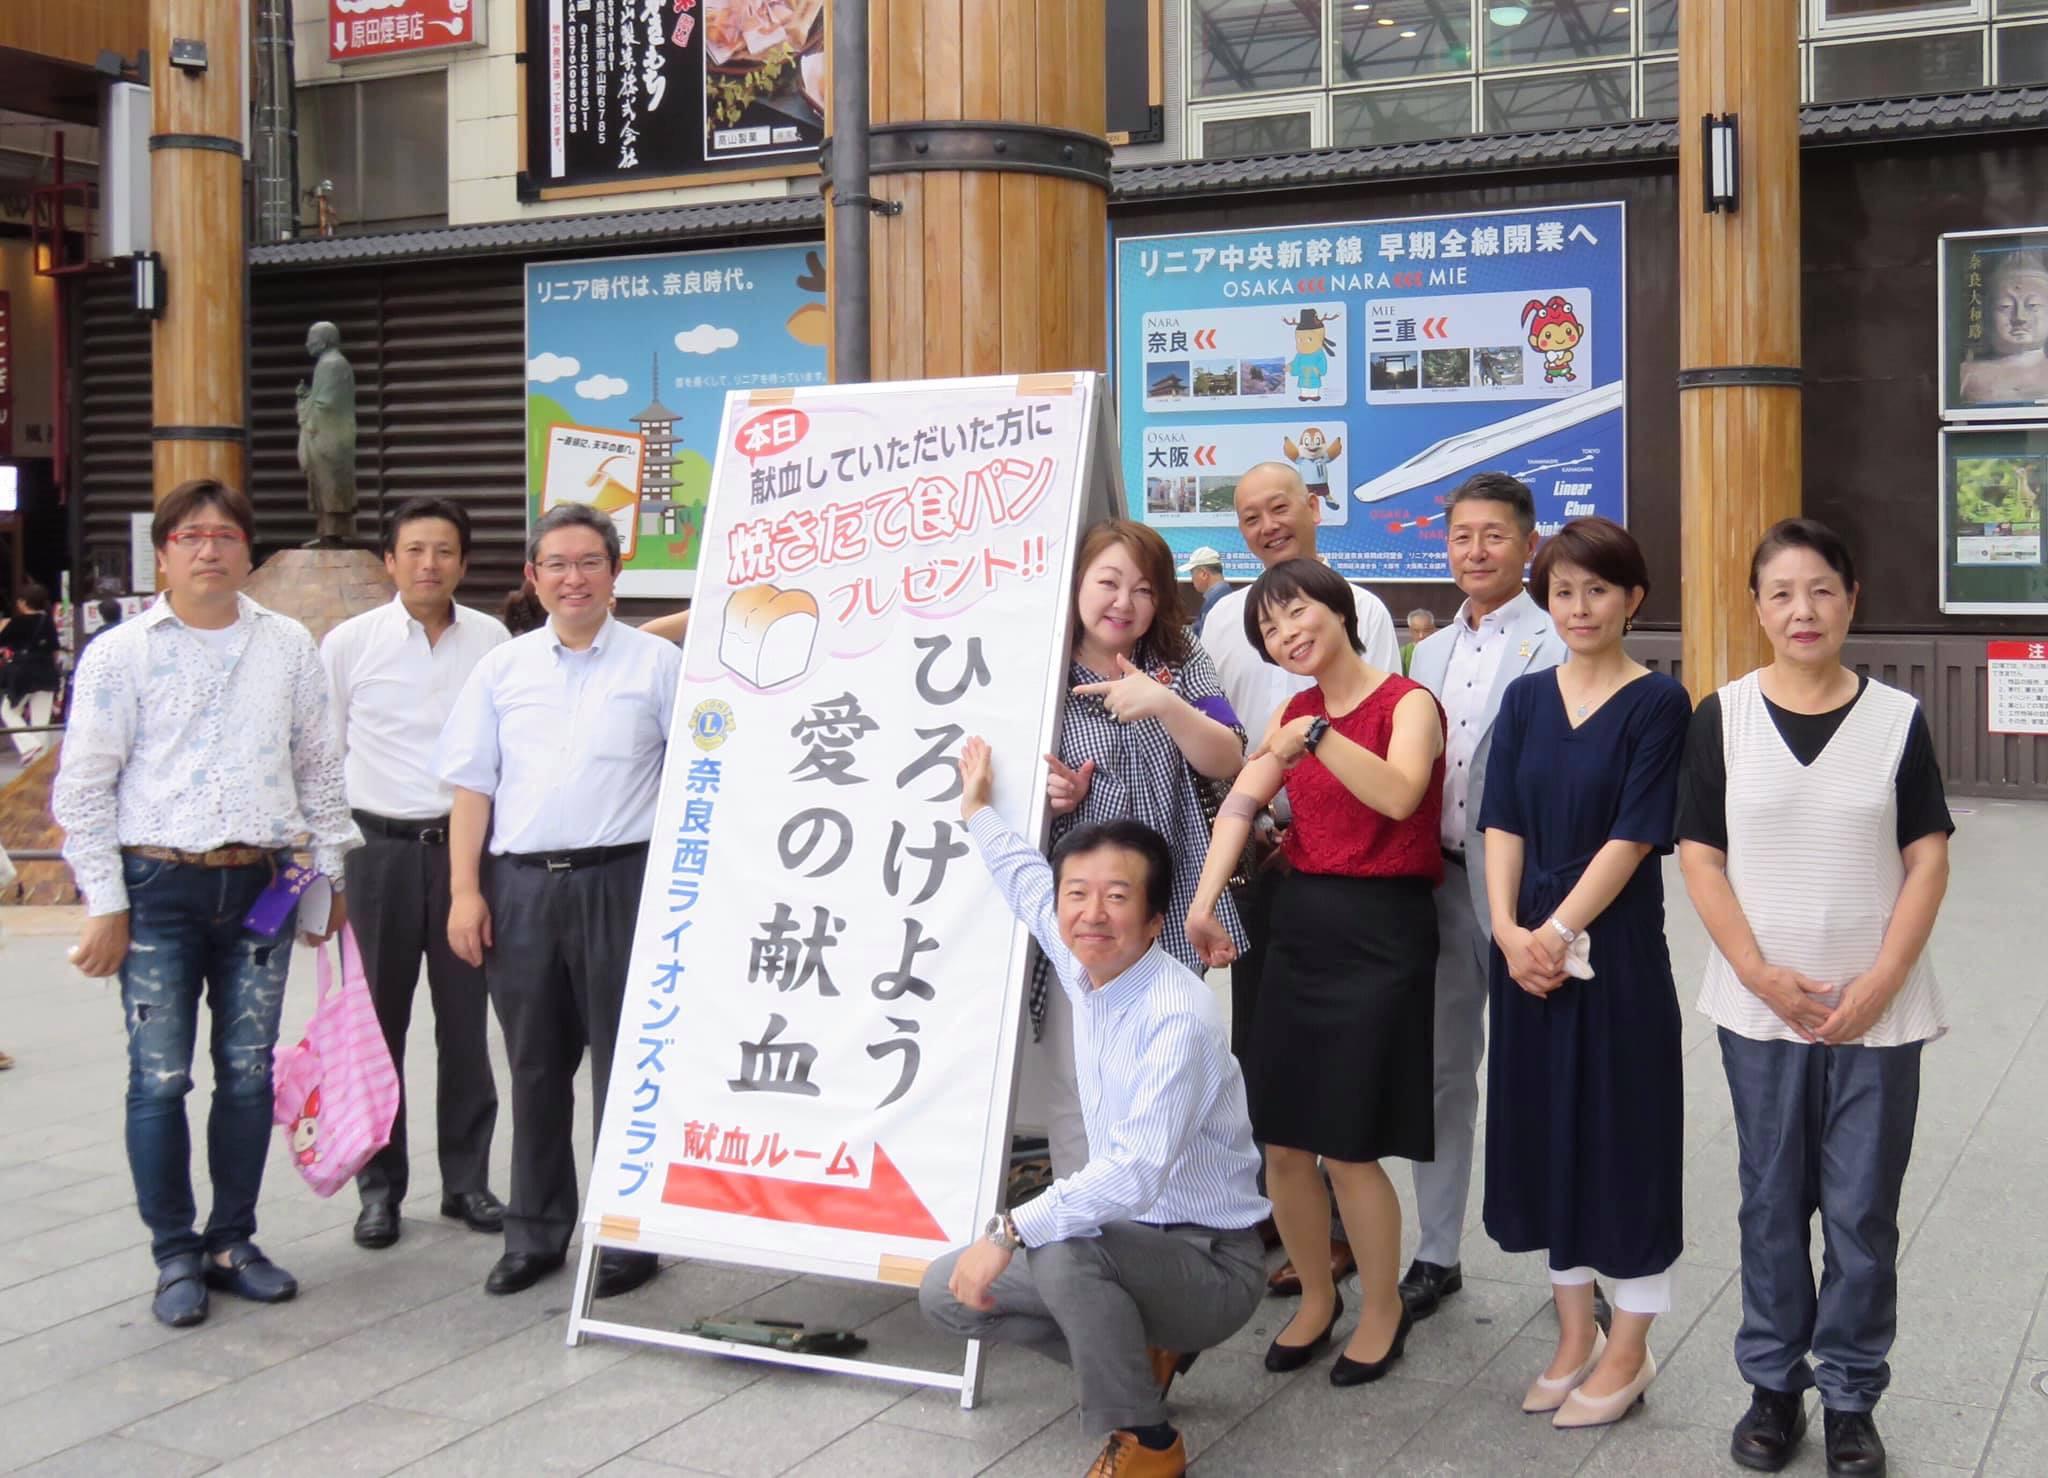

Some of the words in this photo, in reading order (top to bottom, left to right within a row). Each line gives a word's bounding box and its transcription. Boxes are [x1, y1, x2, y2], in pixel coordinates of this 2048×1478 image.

[568, 0, 577, 22] AX
[1140, 235, 1363, 277] リニア中央新幹線
[1378, 221, 1598, 263] 早期全線開業へ
[536, 267, 754, 303] リニア時代は、奈良時代。
[1223, 277, 1295, 298] OSAKA
[1331, 271, 1391, 292] NARA
[1429, 266, 1467, 286] MIE
[1147, 318, 1181, 328] NARA
[1372, 318, 1417, 342] 三重
[1148, 330, 1188, 353] 奈良
[744, 423, 797, 452] 本日
[750, 403, 1053, 506] 献血していただいた方に
[1148, 446, 1189, 468] 大阪
[1553, 480, 1592, 496] Linear
[727, 457, 1055, 586] 焼きたて食パン
[865, 633, 991, 1112] ひろげよう
[727, 691, 881, 1096] 愛の献血
[618, 758, 723, 1197] 奈良西ライオンズクラブ
[683, 1120, 861, 1178] 献血ルーム
